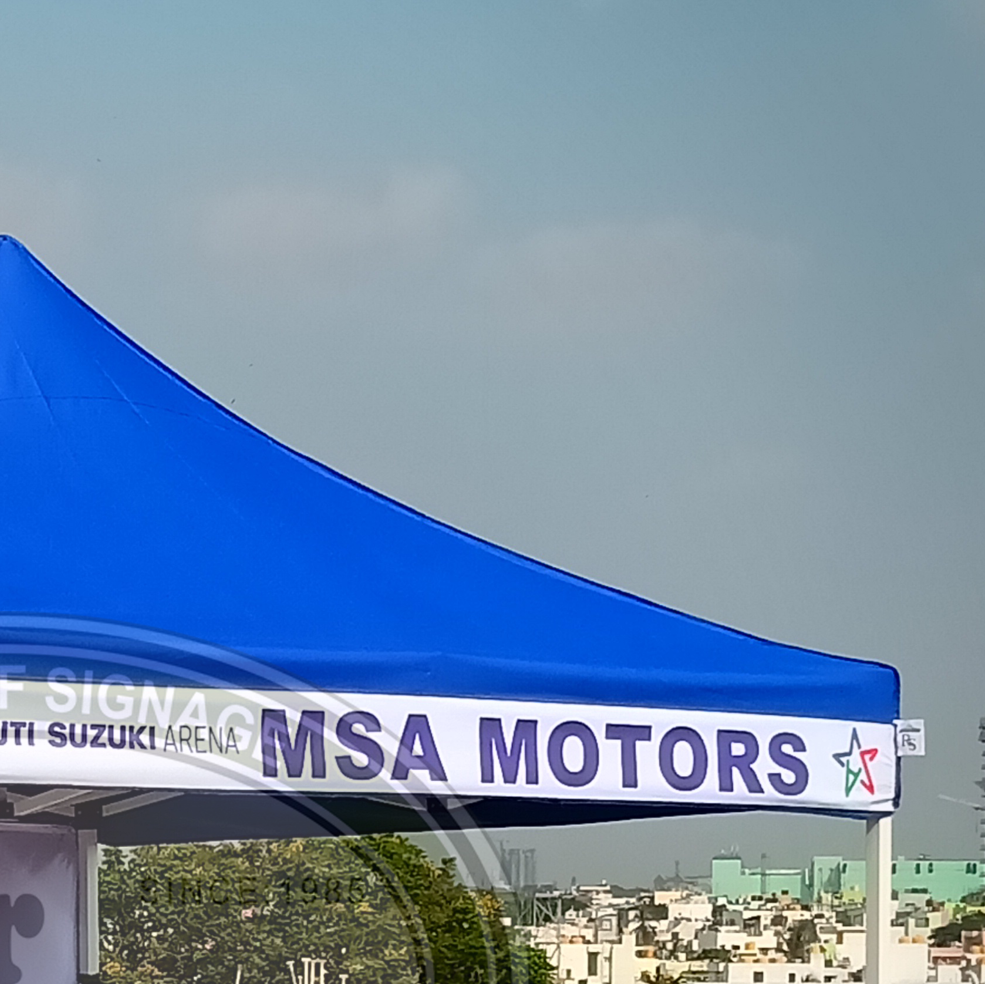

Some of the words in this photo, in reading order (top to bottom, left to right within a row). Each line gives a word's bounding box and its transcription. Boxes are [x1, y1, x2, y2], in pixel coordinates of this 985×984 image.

[47, 721, 157, 751] SUZUKI
[163, 724, 240, 755] ARENA
[260, 708, 448, 783] MSA
[479, 716, 811, 797] MOTORS
